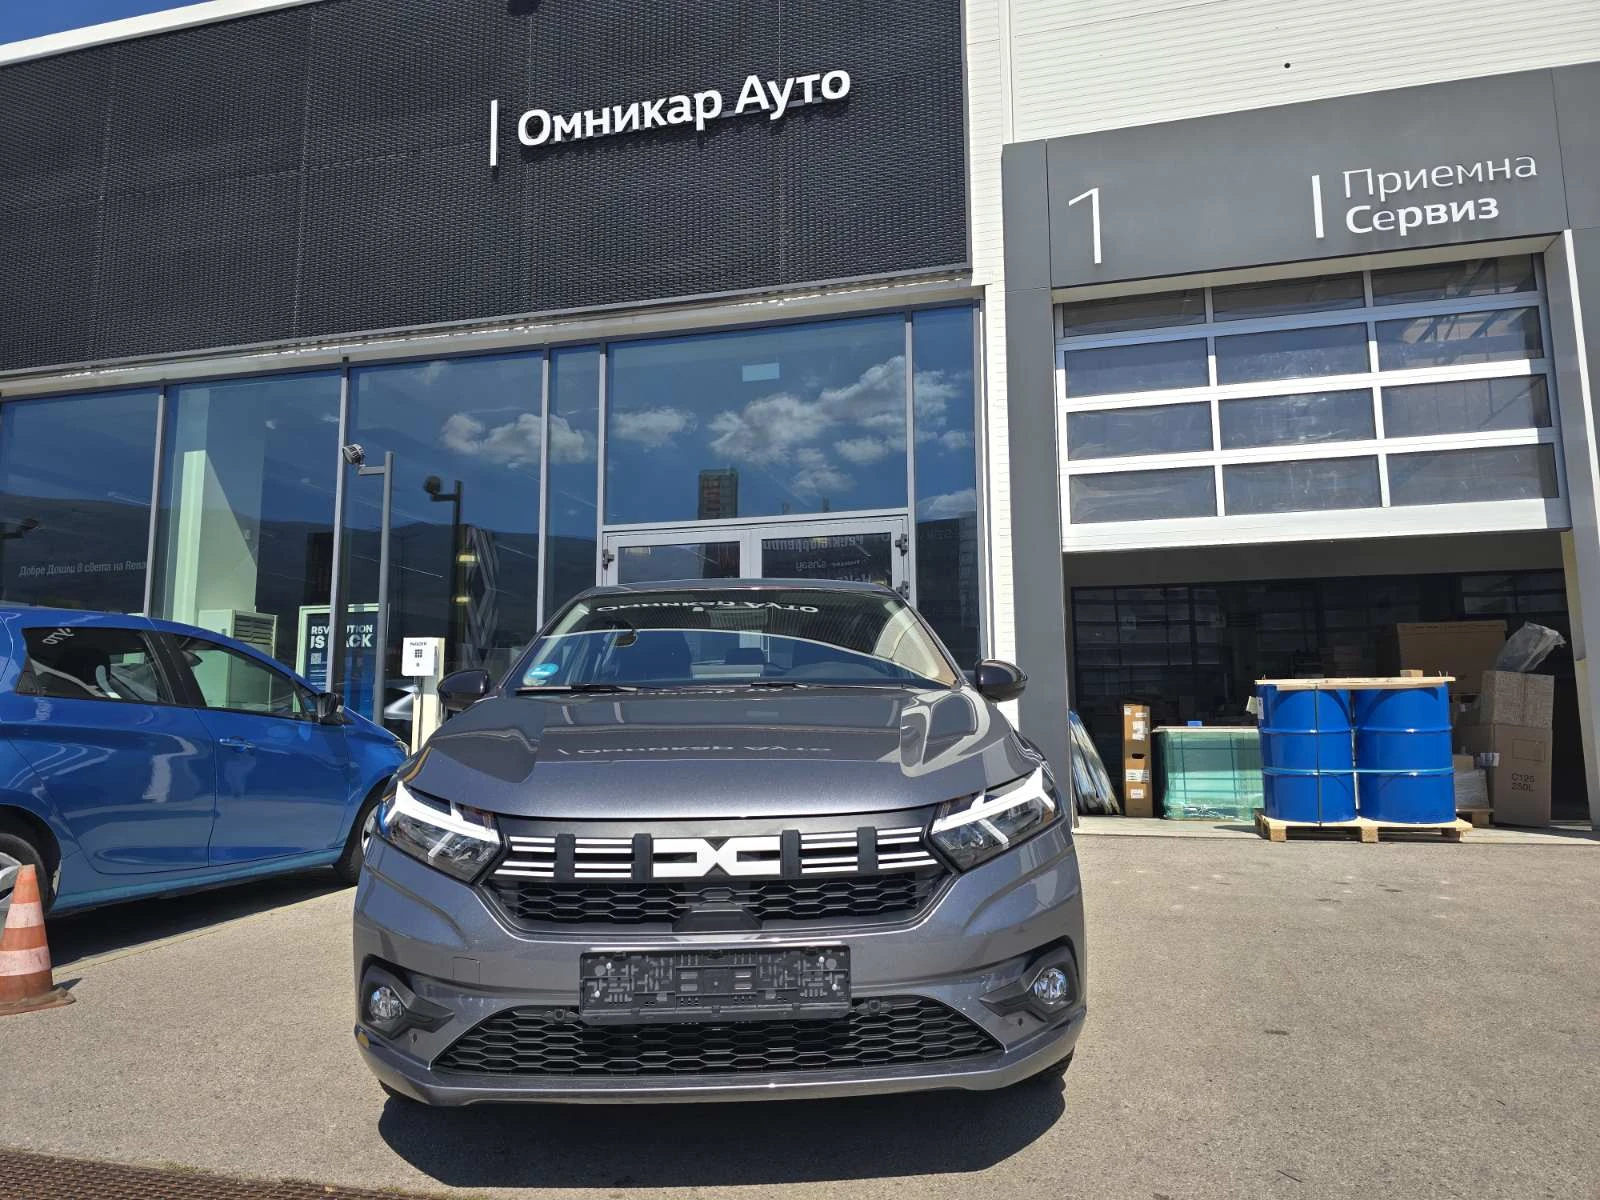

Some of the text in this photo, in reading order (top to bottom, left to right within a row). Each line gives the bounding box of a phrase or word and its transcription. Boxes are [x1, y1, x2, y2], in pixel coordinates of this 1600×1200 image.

[517, 69, 851, 146] Омникар Ауто
[1342, 156, 1537, 201] Приемна
[1068, 187, 1102, 265] 1
[1345, 197, 1499, 236] Сервиз
[310, 634, 325, 649] IS
[311, 624, 373, 635] R5VTION
[345, 633, 374, 648] CK
